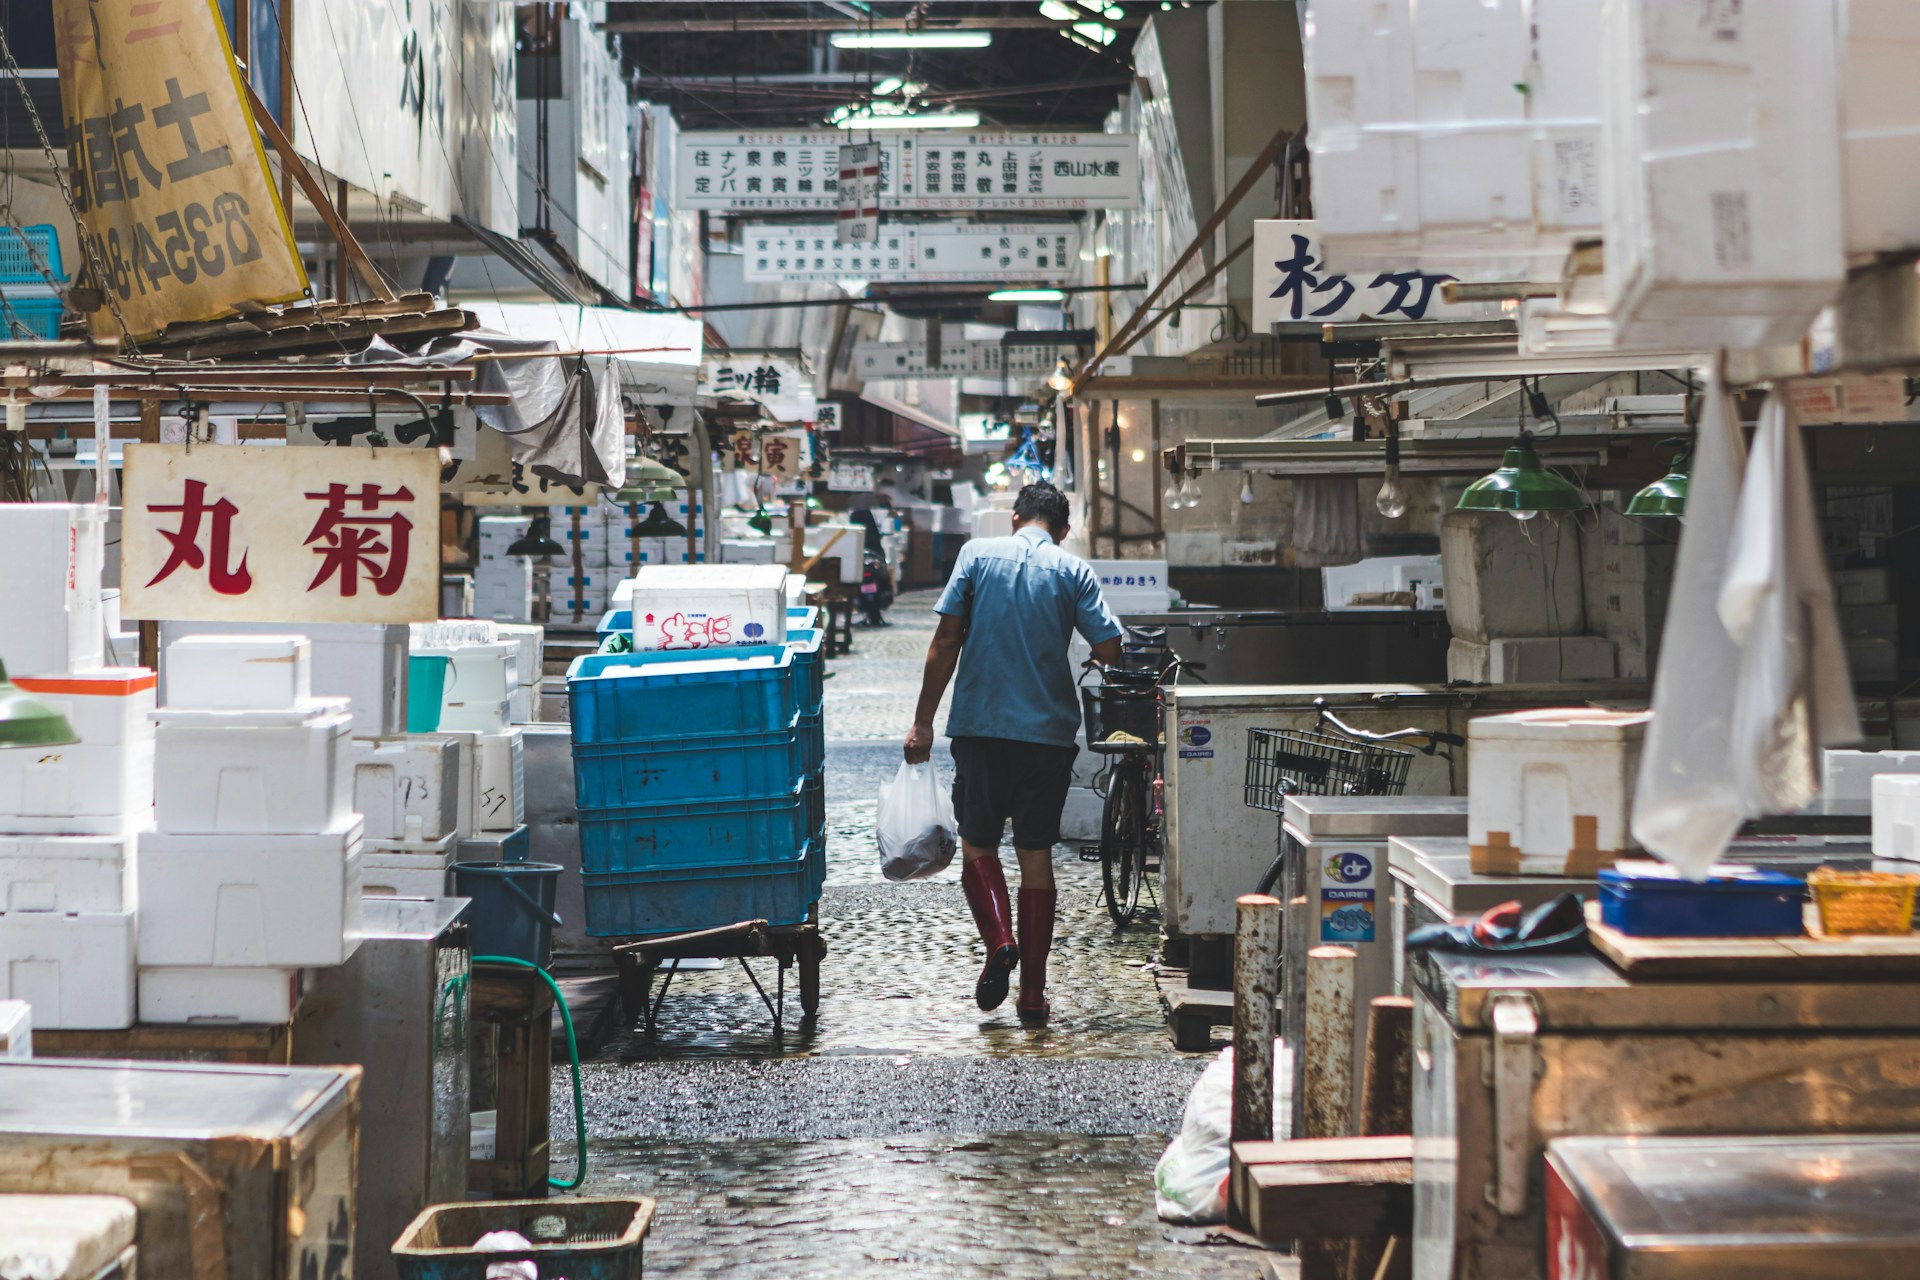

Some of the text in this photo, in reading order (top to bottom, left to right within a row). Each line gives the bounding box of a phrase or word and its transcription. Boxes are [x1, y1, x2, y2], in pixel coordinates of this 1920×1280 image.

[720, 151, 736, 192] ナンバ
[1054, 160, 1120, 177] 西山水産
[850, 224, 866, 239] 4000
[713, 365, 782, 395] 三ツ輪
[144, 478, 416, 597] 丸菊
[398, 776, 429, 808] 73
[1344, 860, 1368, 876] dr
[1328, 890, 1368, 898] DAIREI
